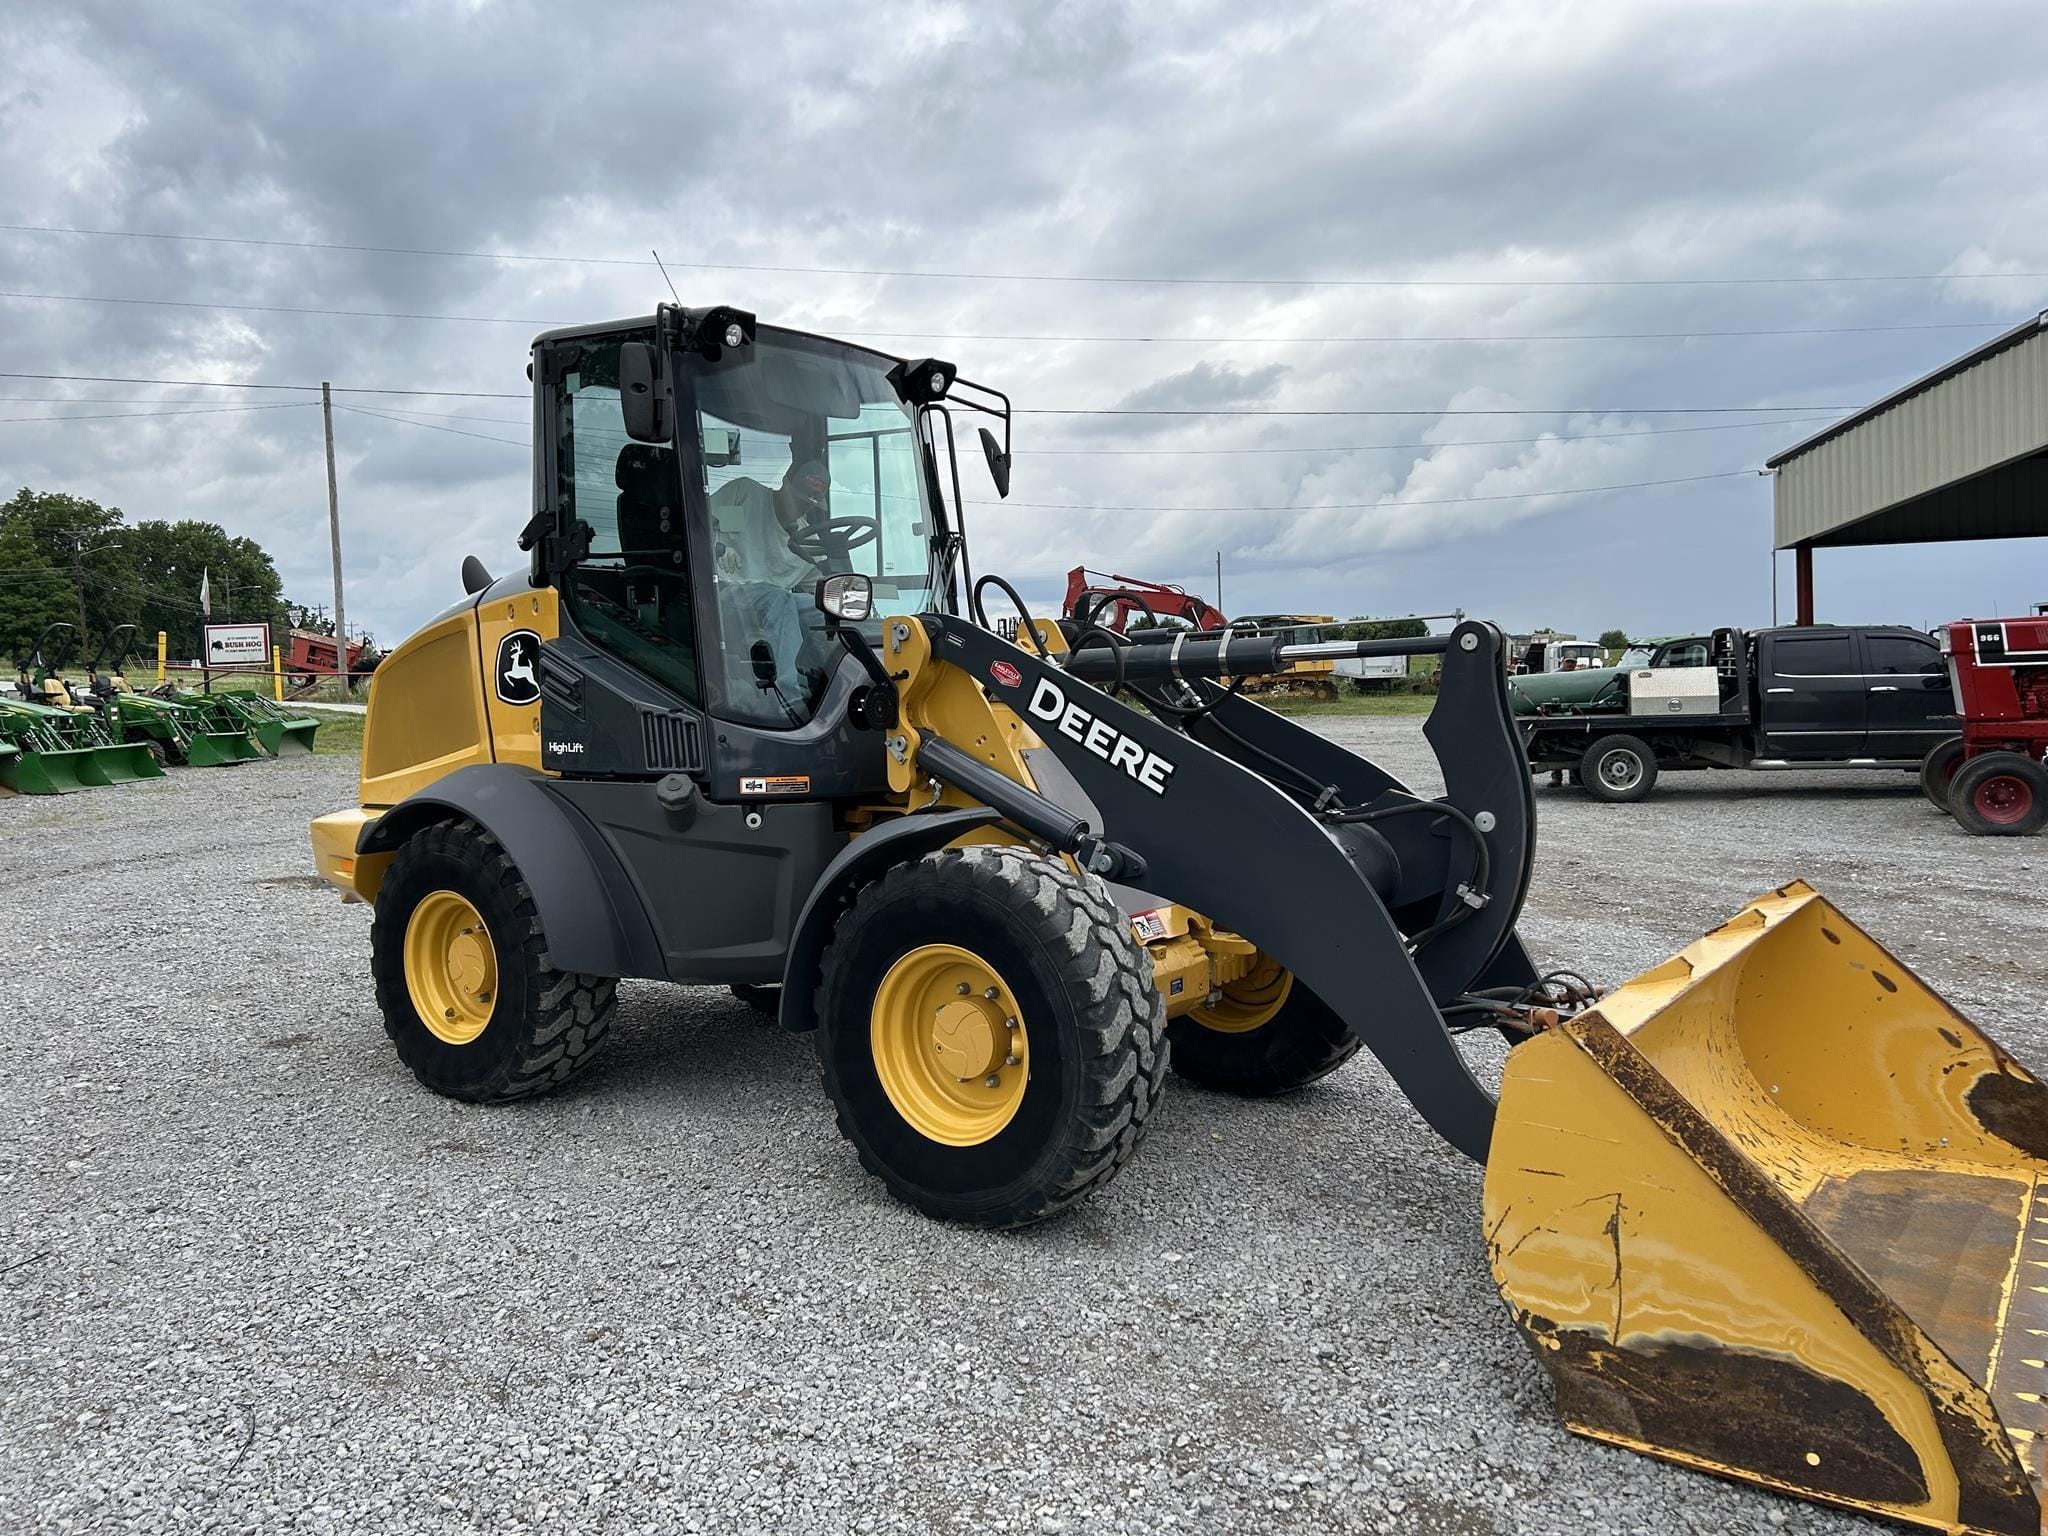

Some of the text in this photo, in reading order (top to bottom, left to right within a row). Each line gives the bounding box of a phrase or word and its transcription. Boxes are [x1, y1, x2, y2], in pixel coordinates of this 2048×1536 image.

[224, 640, 262, 649] BUSH HOG
[1028, 677, 1175, 795] DEERE
